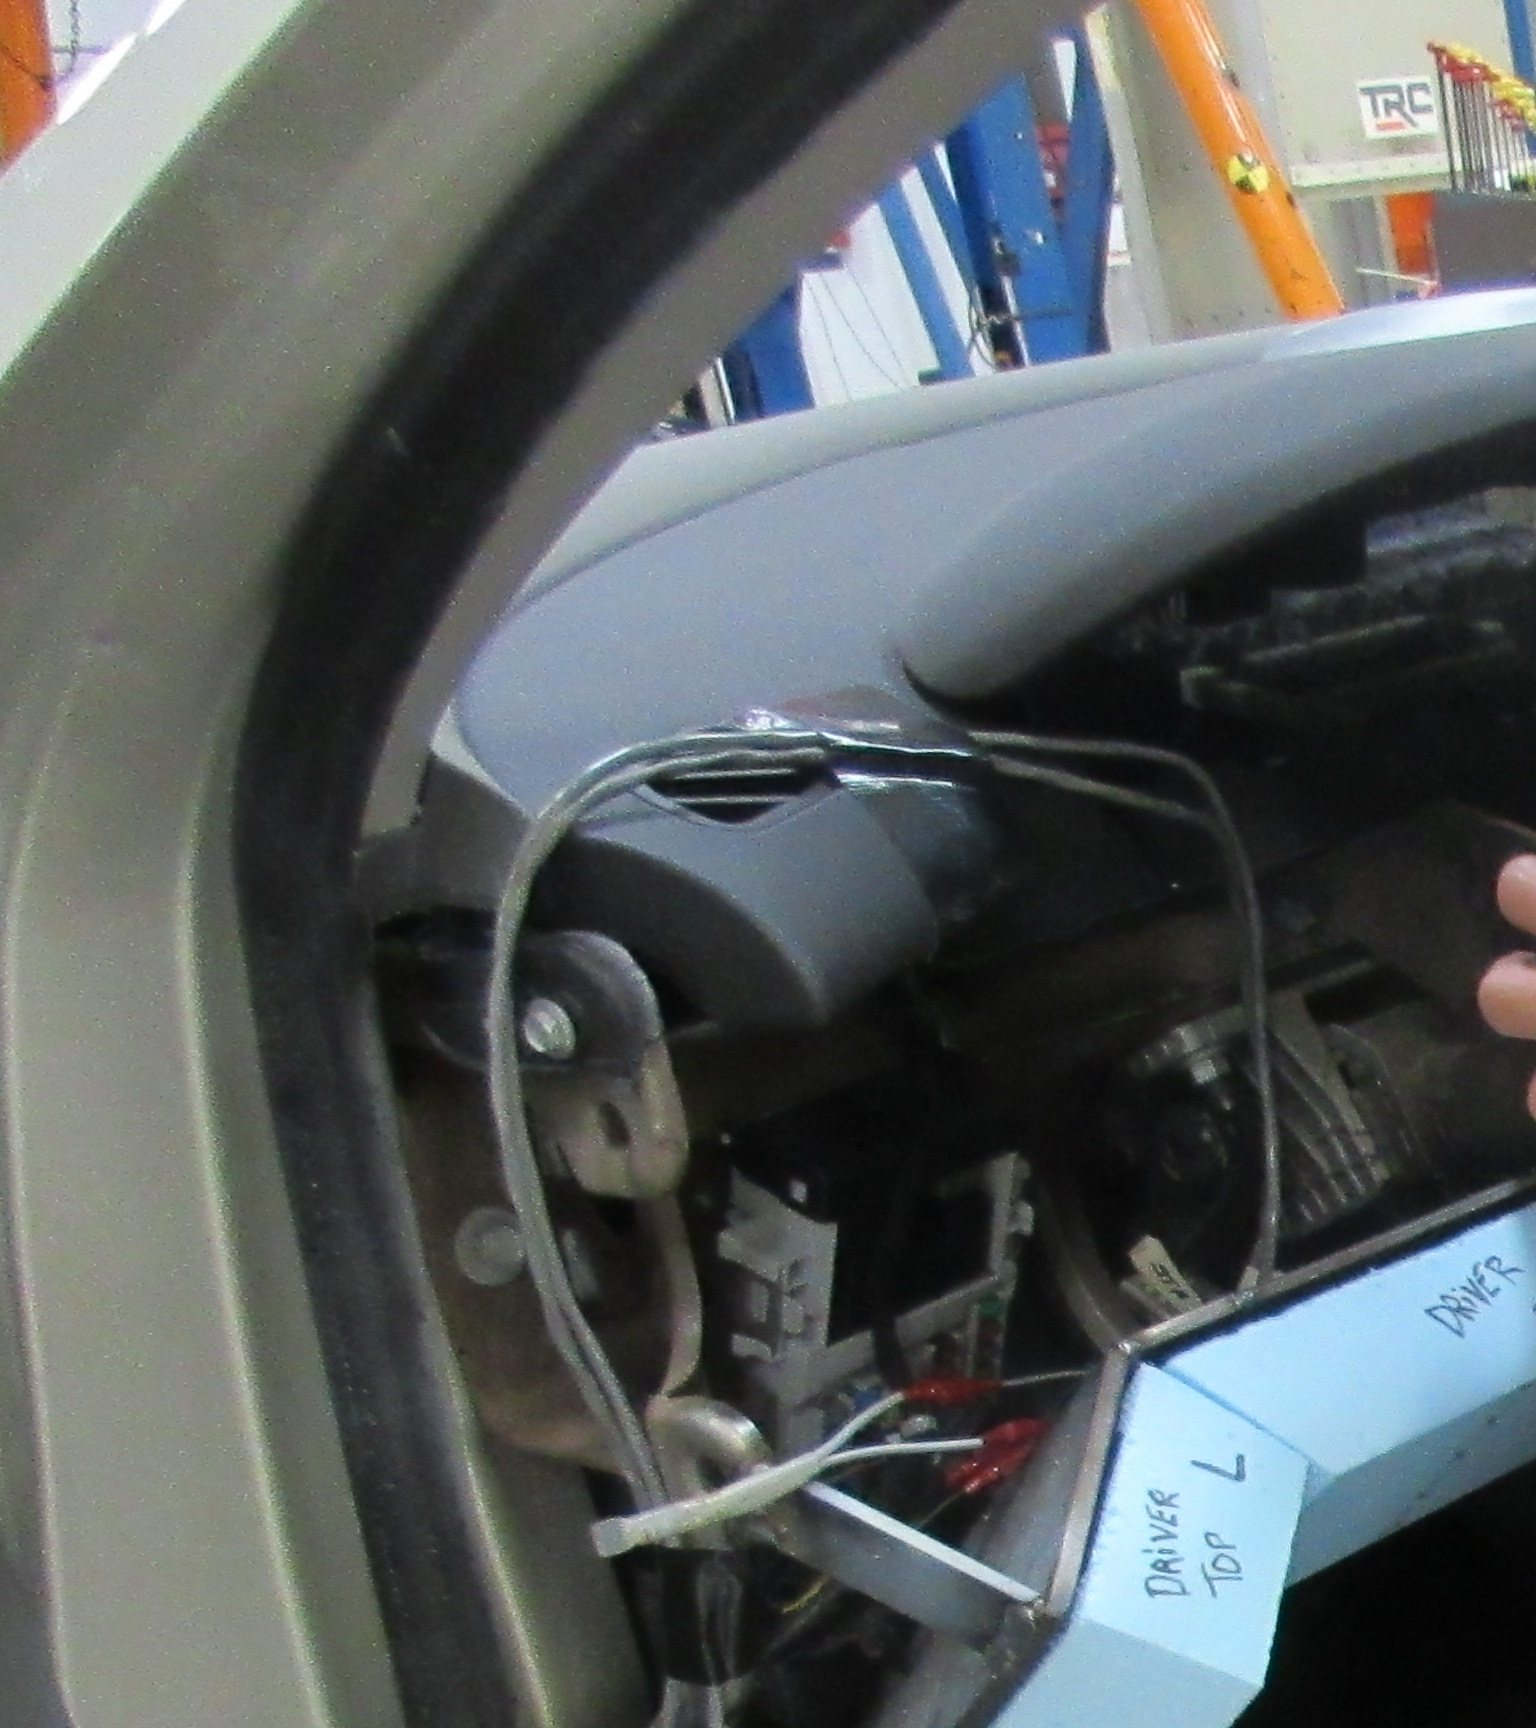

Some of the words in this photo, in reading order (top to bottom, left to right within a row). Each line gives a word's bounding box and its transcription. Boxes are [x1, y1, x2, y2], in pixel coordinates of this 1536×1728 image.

[1359, 82, 1434, 129] TRC
[1190, 1453, 1246, 1482] L
[1201, 1531, 1244, 1598] TOP
